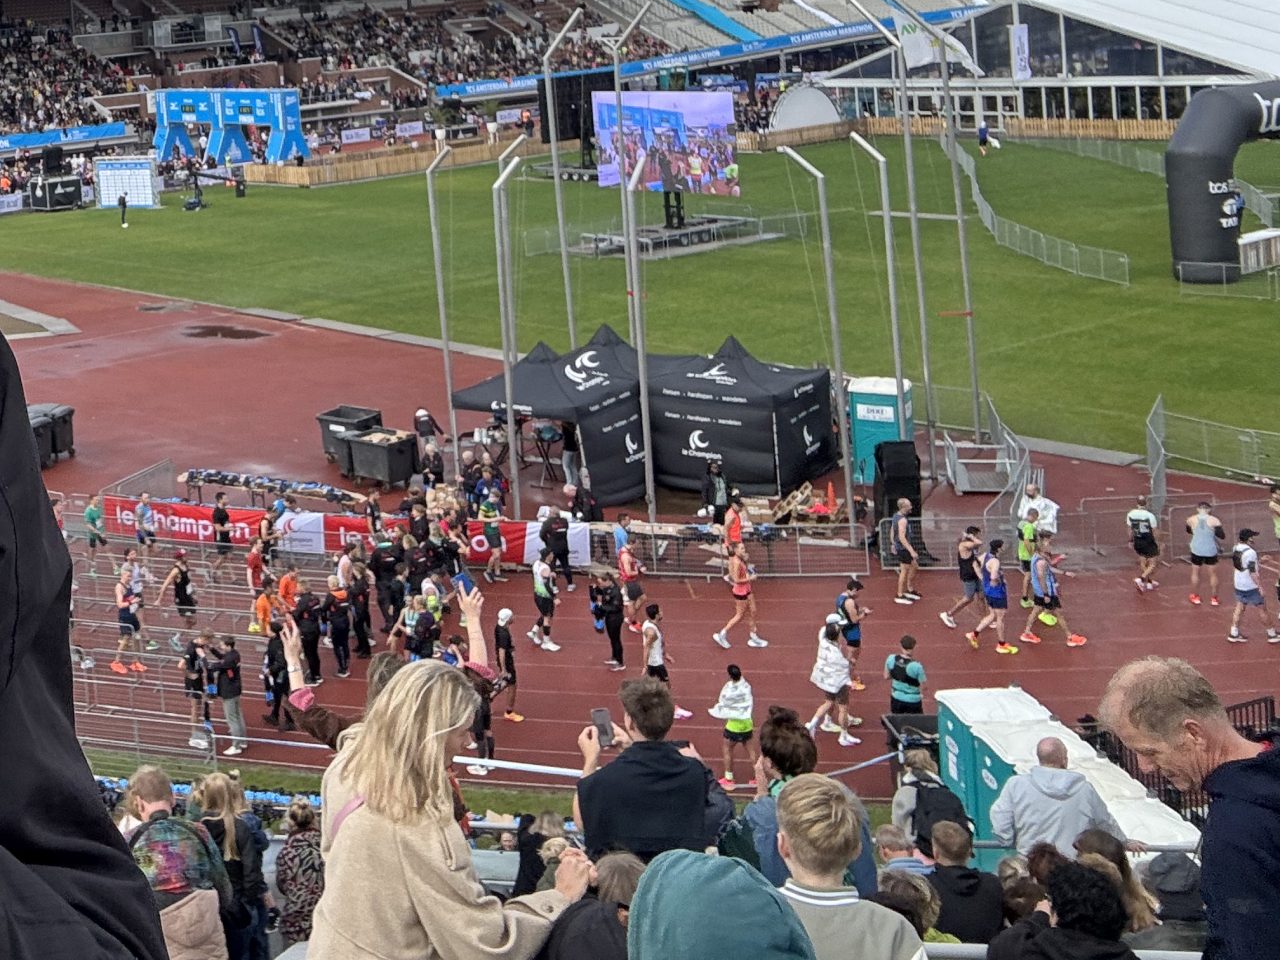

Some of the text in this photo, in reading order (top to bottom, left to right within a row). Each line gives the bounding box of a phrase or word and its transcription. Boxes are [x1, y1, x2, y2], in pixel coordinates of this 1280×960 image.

[801, 28, 838, 42] AMSTERDAM
[1208, 180, 1228, 194] tcs
[116, 505, 134, 525] le
